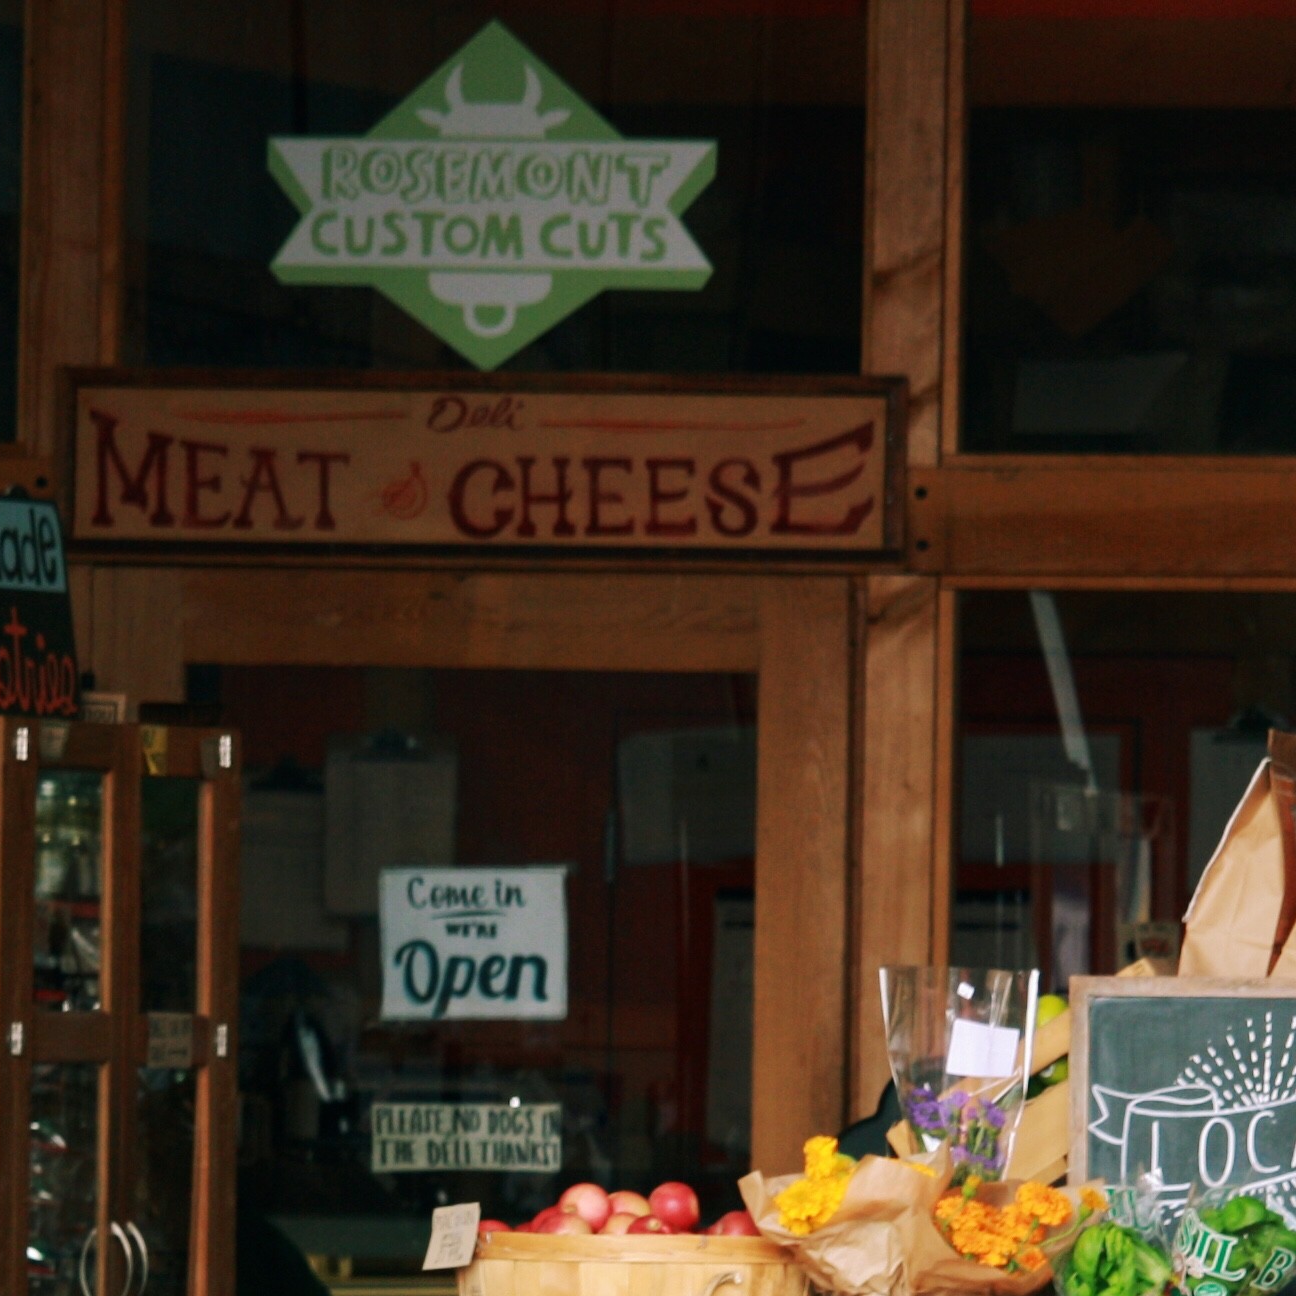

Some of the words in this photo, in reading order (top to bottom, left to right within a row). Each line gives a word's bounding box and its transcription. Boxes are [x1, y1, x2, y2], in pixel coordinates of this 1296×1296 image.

[319, 147, 671, 206] ROSEMONT
[310, 210, 524, 260] CUSTOM
[538, 212, 668, 262] CUTS
[425, 396, 523, 433] Deli
[89, 405, 351, 532] MEAT
[447, 420, 876, 540] CHEESE
[406, 875, 486, 909] Come
[494, 877, 527, 909] in
[392, 938, 549, 1020] Open
[488, 1108, 534, 1135] DOGS
